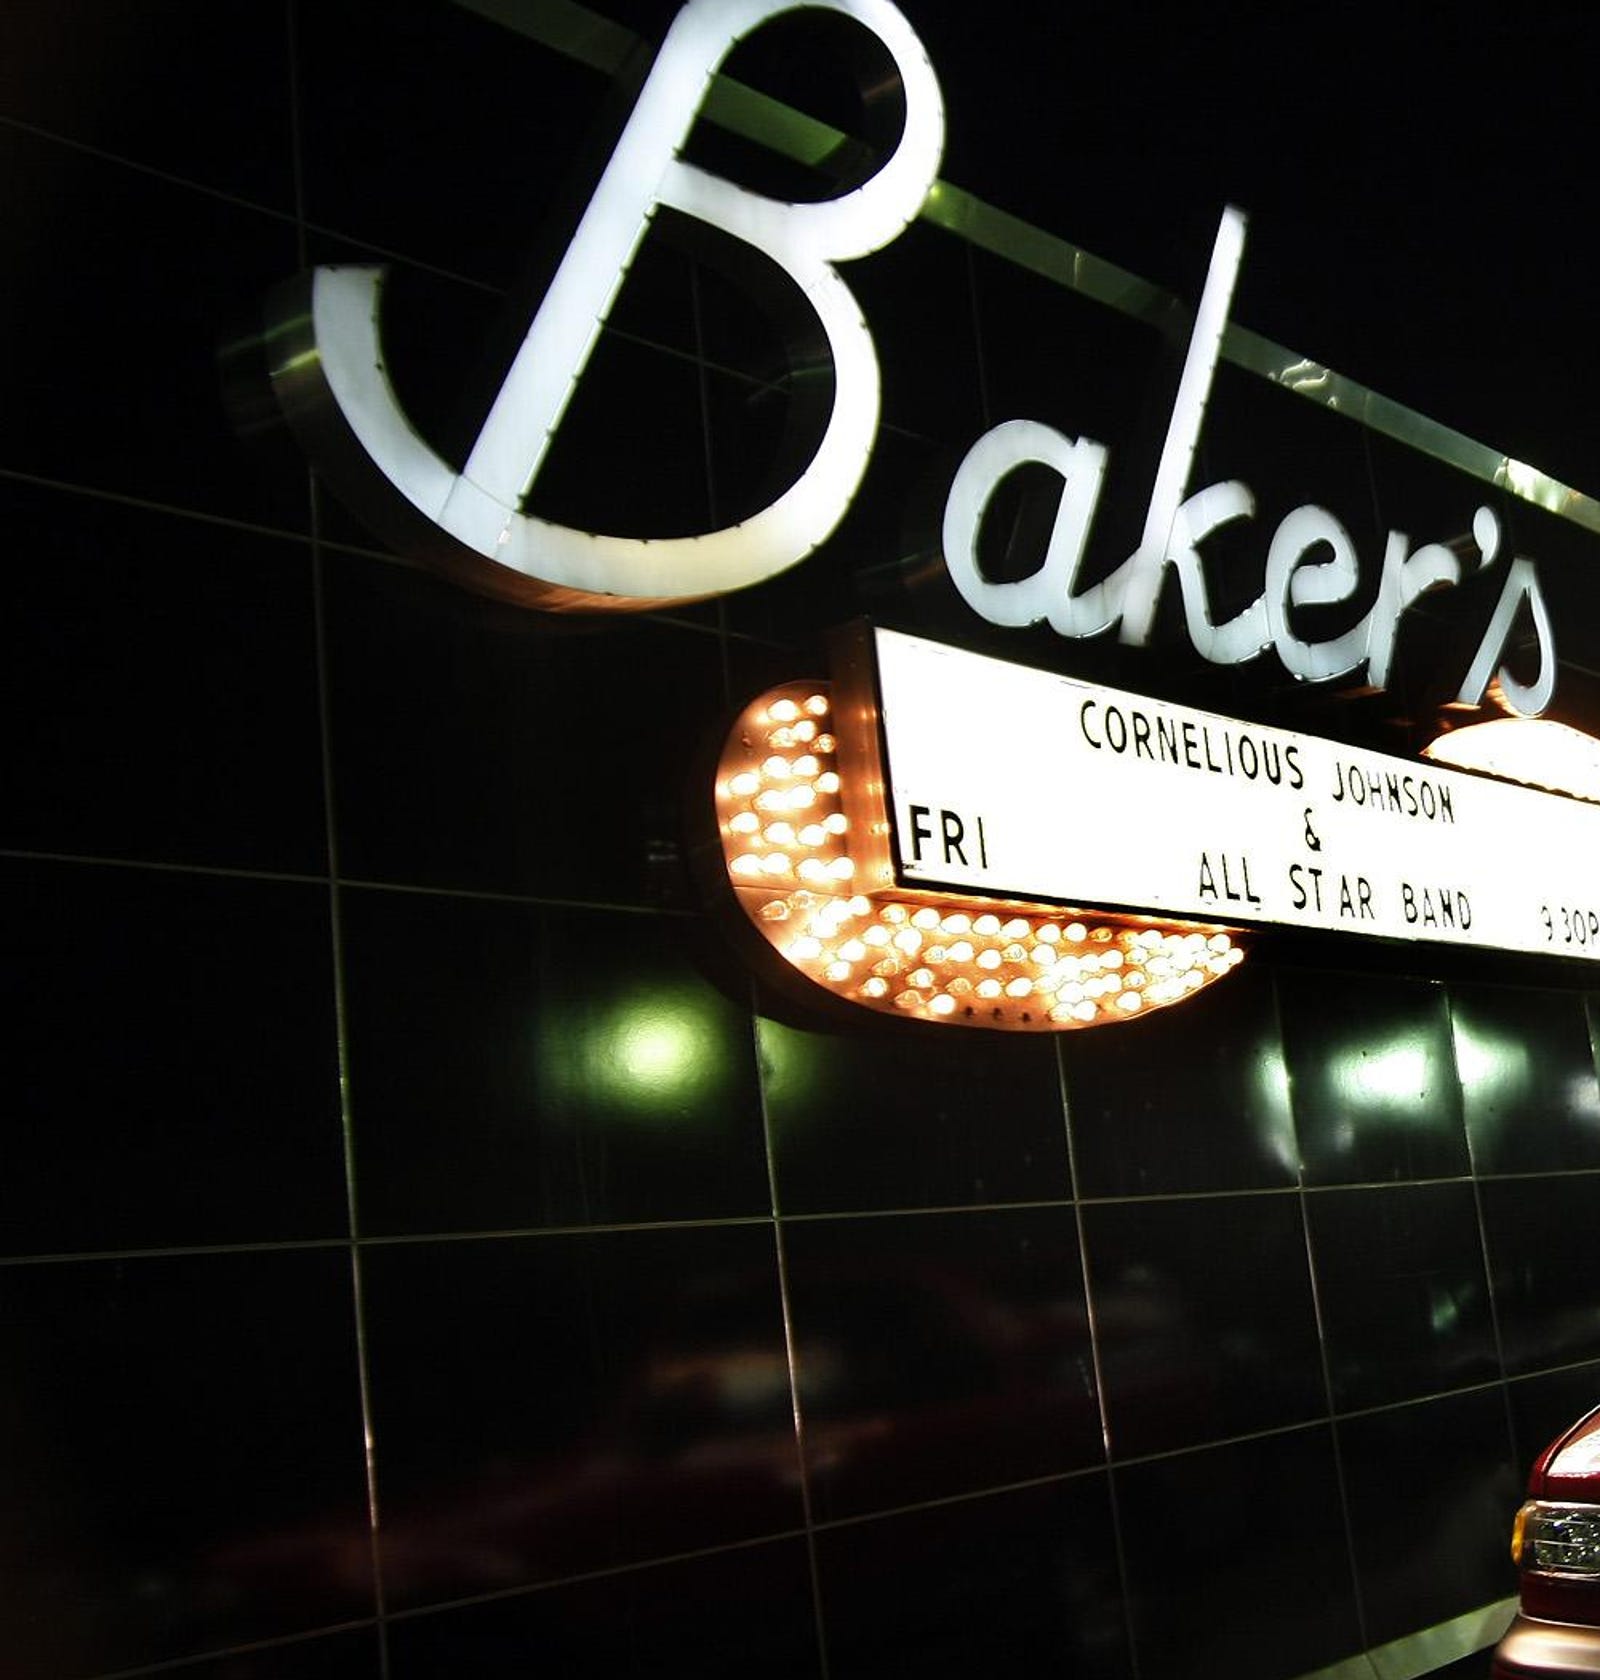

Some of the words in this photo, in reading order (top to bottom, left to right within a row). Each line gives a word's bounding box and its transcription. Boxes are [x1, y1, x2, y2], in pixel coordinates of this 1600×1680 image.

[312, 0, 1557, 718] Baker's
[1080, 699, 1304, 790] CORNELIOUS
[1332, 761, 1455, 824] JOHNSON
[908, 804, 988, 869] FRI
[1198, 852, 1261, 904] ALL
[1401, 882, 1472, 930] BAND
[1303, 807, 1322, 852] &
